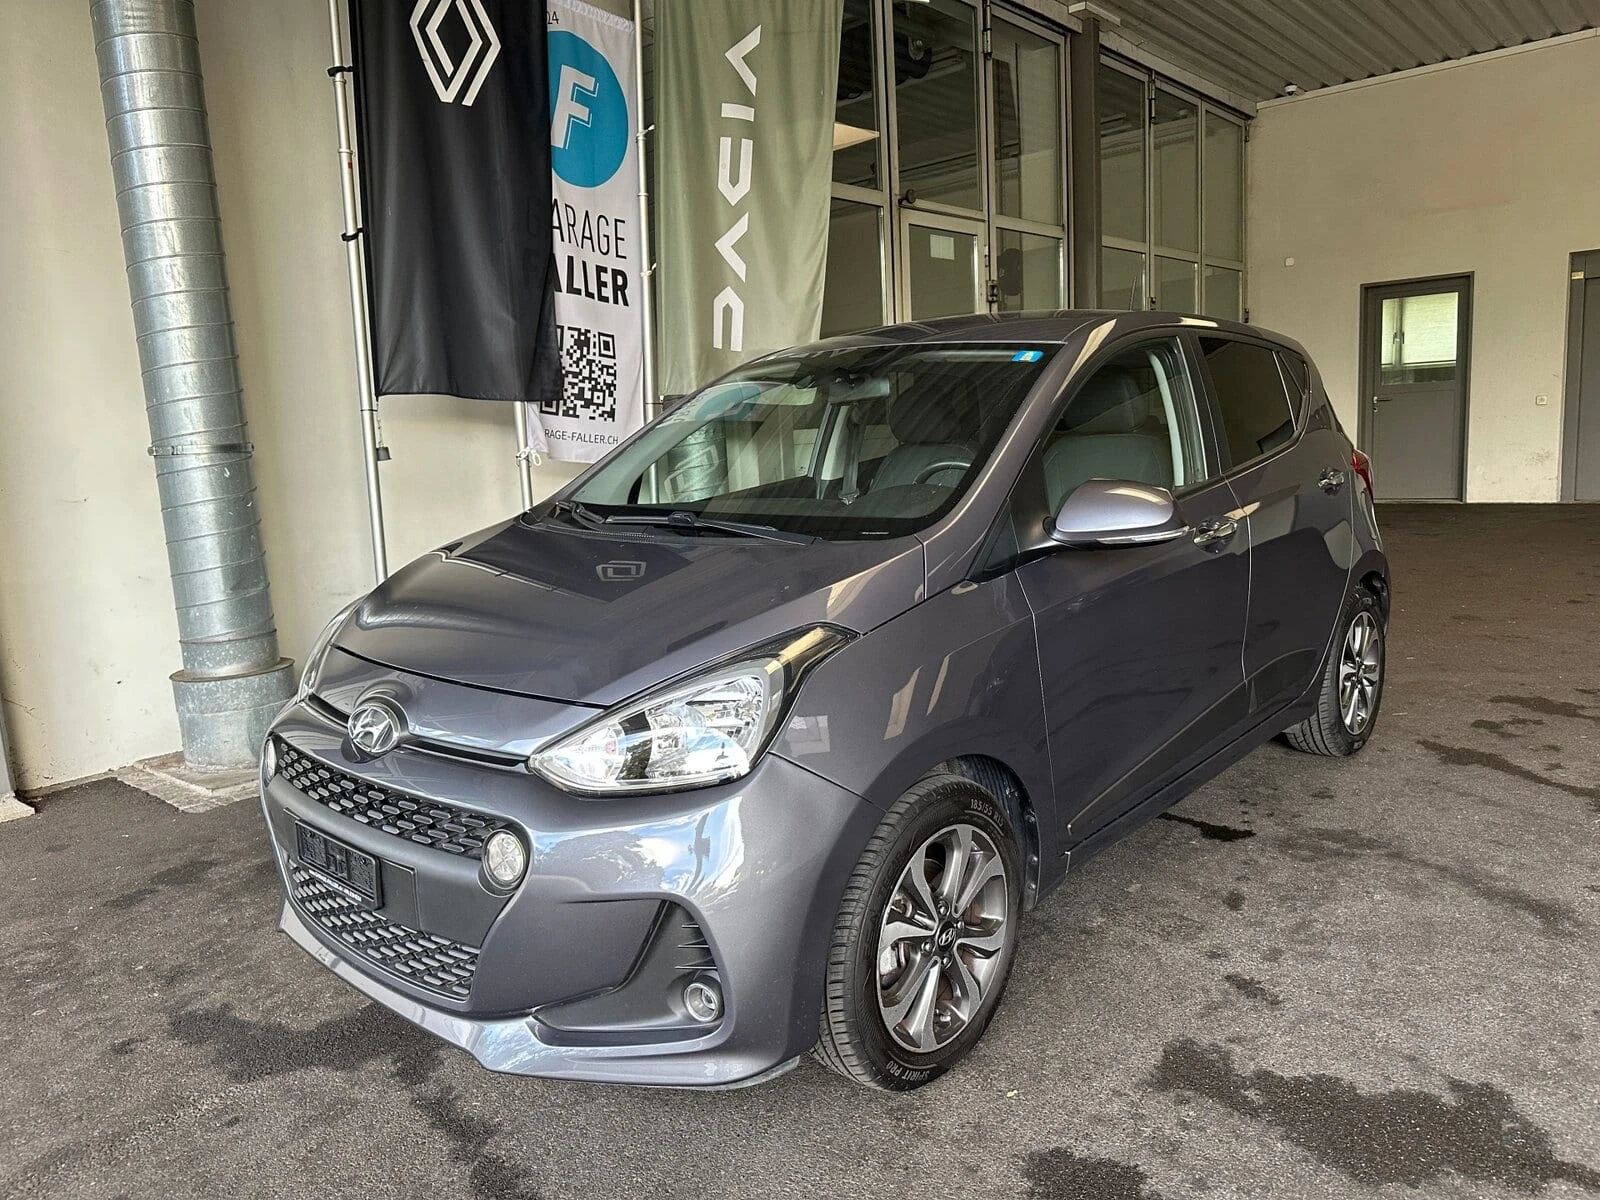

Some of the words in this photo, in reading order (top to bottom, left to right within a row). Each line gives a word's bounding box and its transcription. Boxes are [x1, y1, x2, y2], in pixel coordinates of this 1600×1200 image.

[551, 64, 599, 150] F
[713, 24, 762, 352] DACIA
[552, 198, 627, 260] ARAGE
[544, 428, 619, 445] RAGE-FALLER.CH
